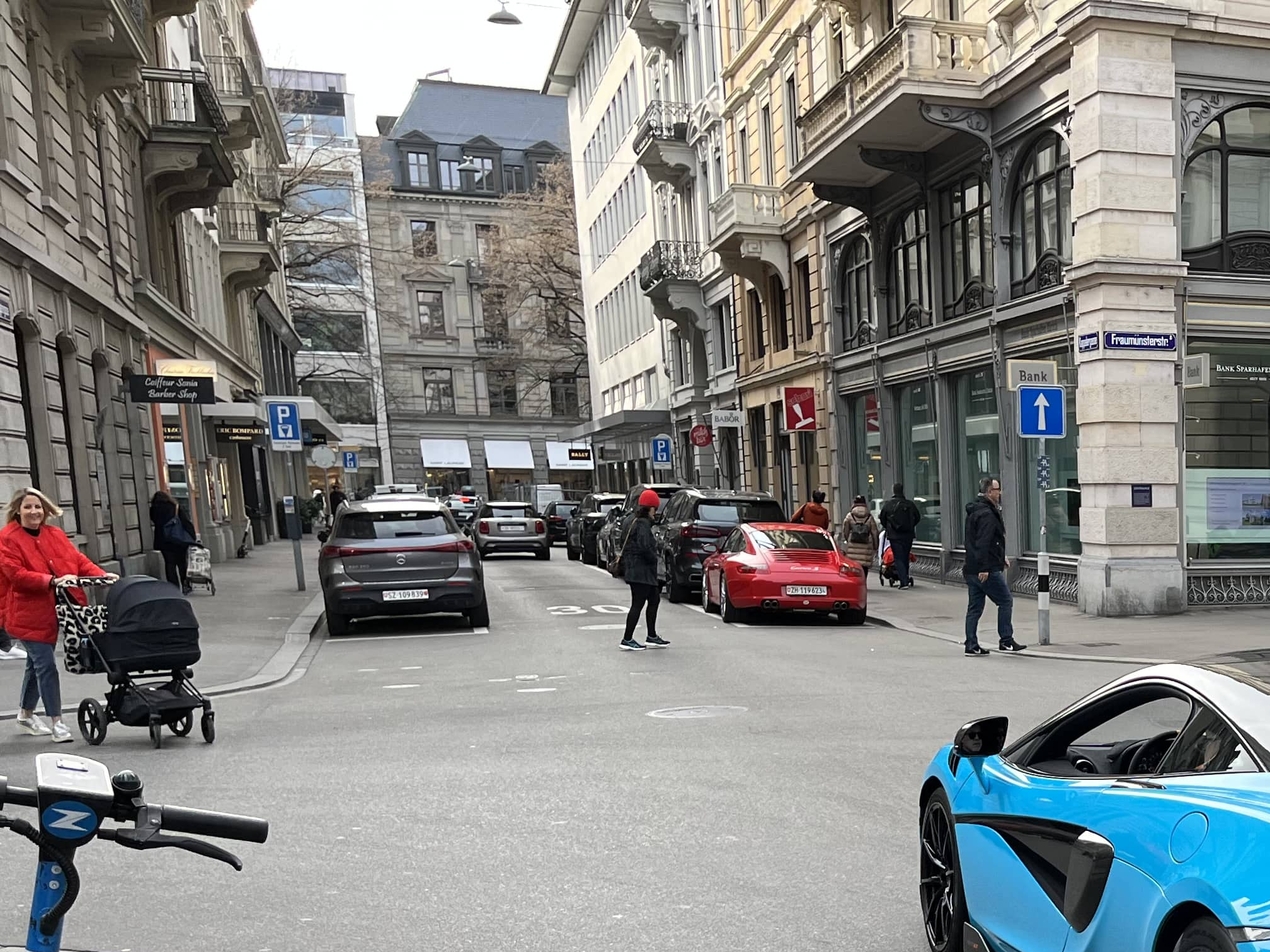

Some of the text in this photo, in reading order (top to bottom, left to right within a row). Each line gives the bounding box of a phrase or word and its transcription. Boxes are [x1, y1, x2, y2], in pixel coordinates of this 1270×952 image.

[1111, 333, 1169, 347] Fraumünsterstr.
[1216, 364, 1235, 373] Bank
[1019, 370, 1048, 382] Bank
[144, 377, 198, 388] Coiffeur Sonia
[148, 388, 198, 402] Barber Shop
[277, 405, 290, 424] P
[714, 414, 740, 423] BABOR
[657, 440, 665, 452] P
[546, 604, 631, 615] 30
